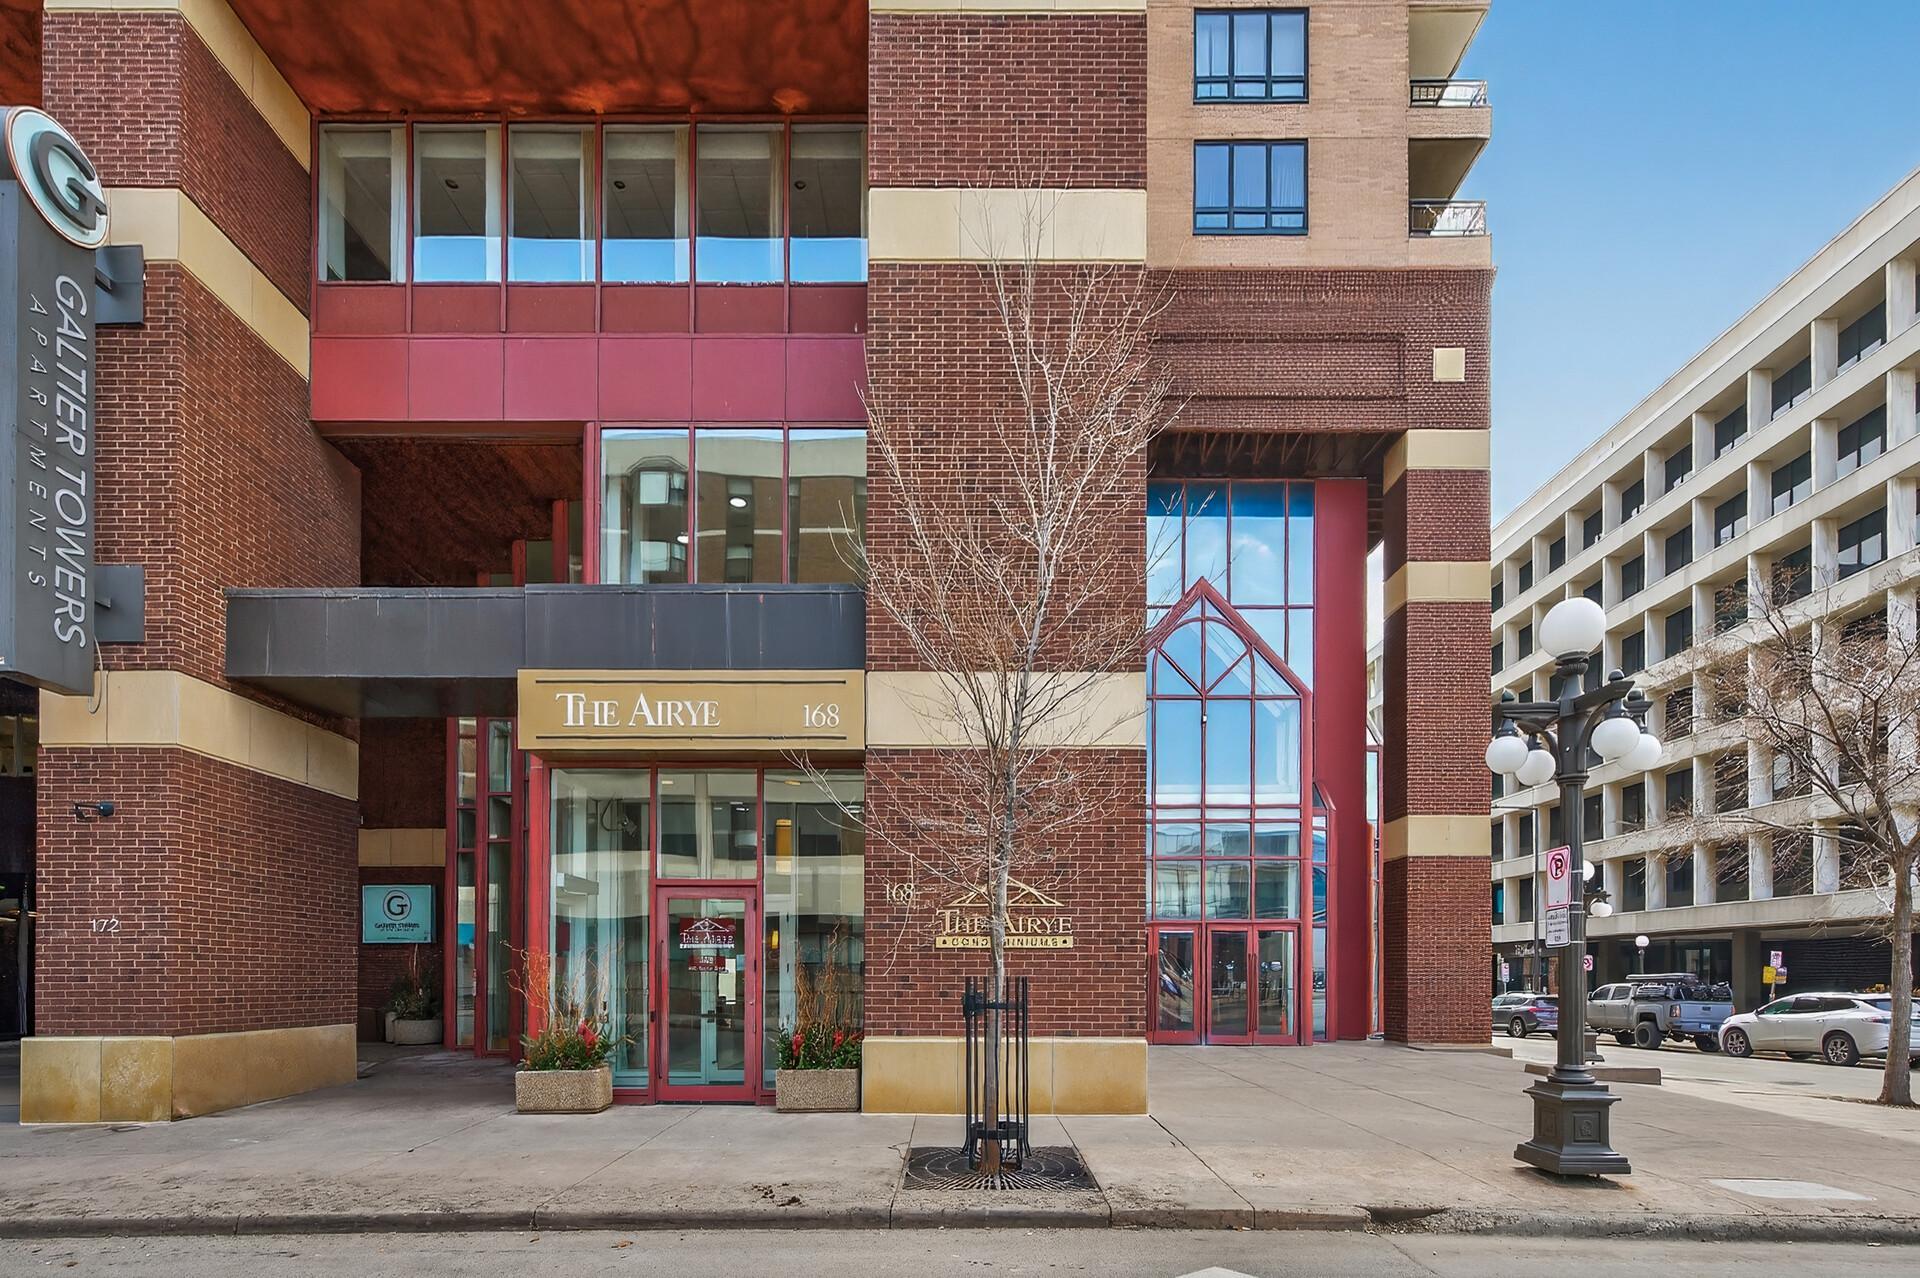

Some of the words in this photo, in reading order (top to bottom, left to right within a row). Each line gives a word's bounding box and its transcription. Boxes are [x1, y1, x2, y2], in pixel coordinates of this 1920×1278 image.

[29, 131, 108, 231] G
[55, 275, 88, 456] GALTIER
[28, 293, 49, 588] APARTMENTS
[54, 466, 87, 648] TOWERS
[555, 692, 620, 728] THE
[628, 692, 721, 728] AIRYE
[803, 703, 840, 728] 168
[91, 918, 121, 933] 172
